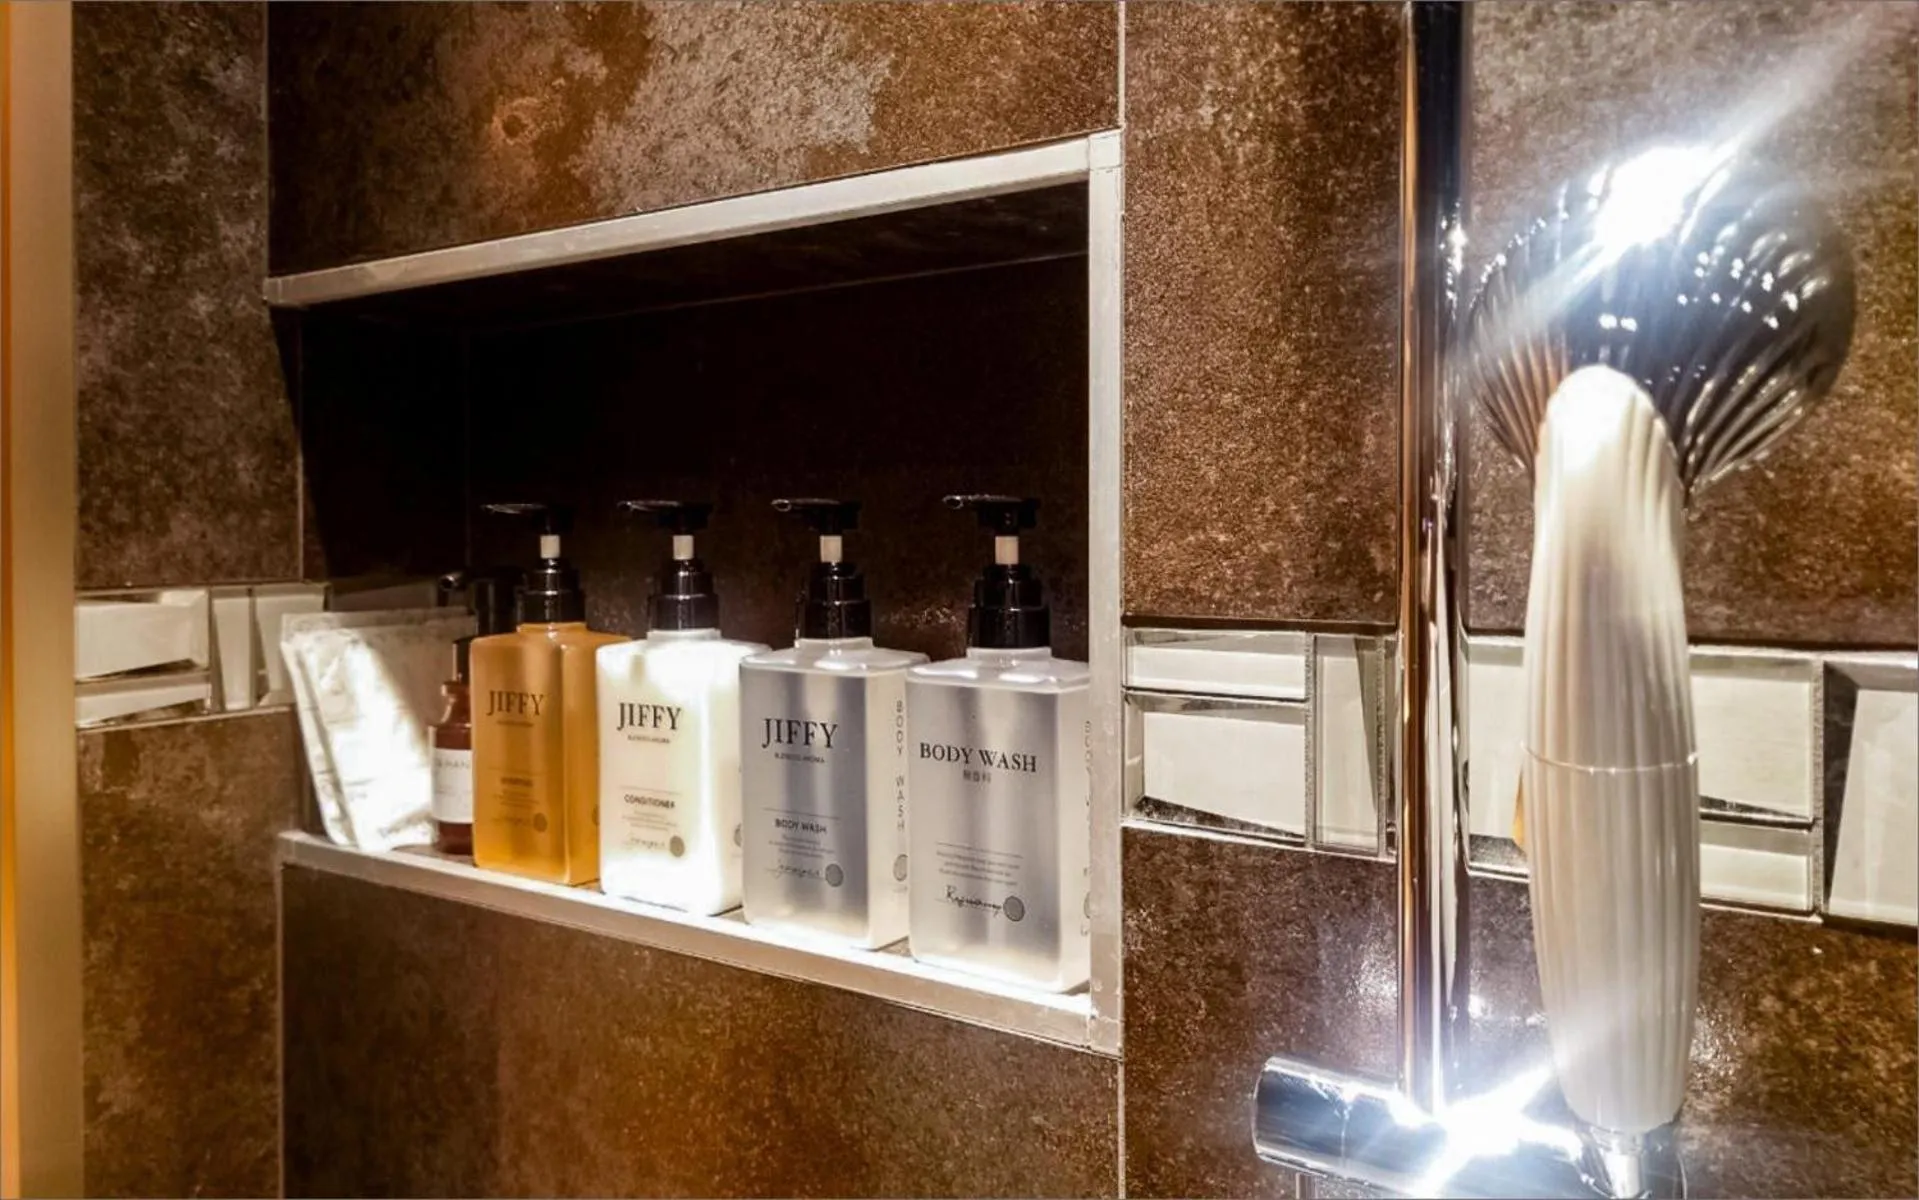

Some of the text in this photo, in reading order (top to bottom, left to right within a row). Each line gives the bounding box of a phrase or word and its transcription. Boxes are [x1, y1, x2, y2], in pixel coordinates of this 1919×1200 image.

[486, 690, 544, 716] JIFFY
[616, 702, 681, 731] JIFFY
[762, 718, 838, 749] JIFFY
[895, 700, 906, 833] BODY WASH
[919, 742, 1037, 773] BODY WASH
[623, 793, 676, 809] CONDITIONER
[775, 818, 827, 834] BODY WASH
